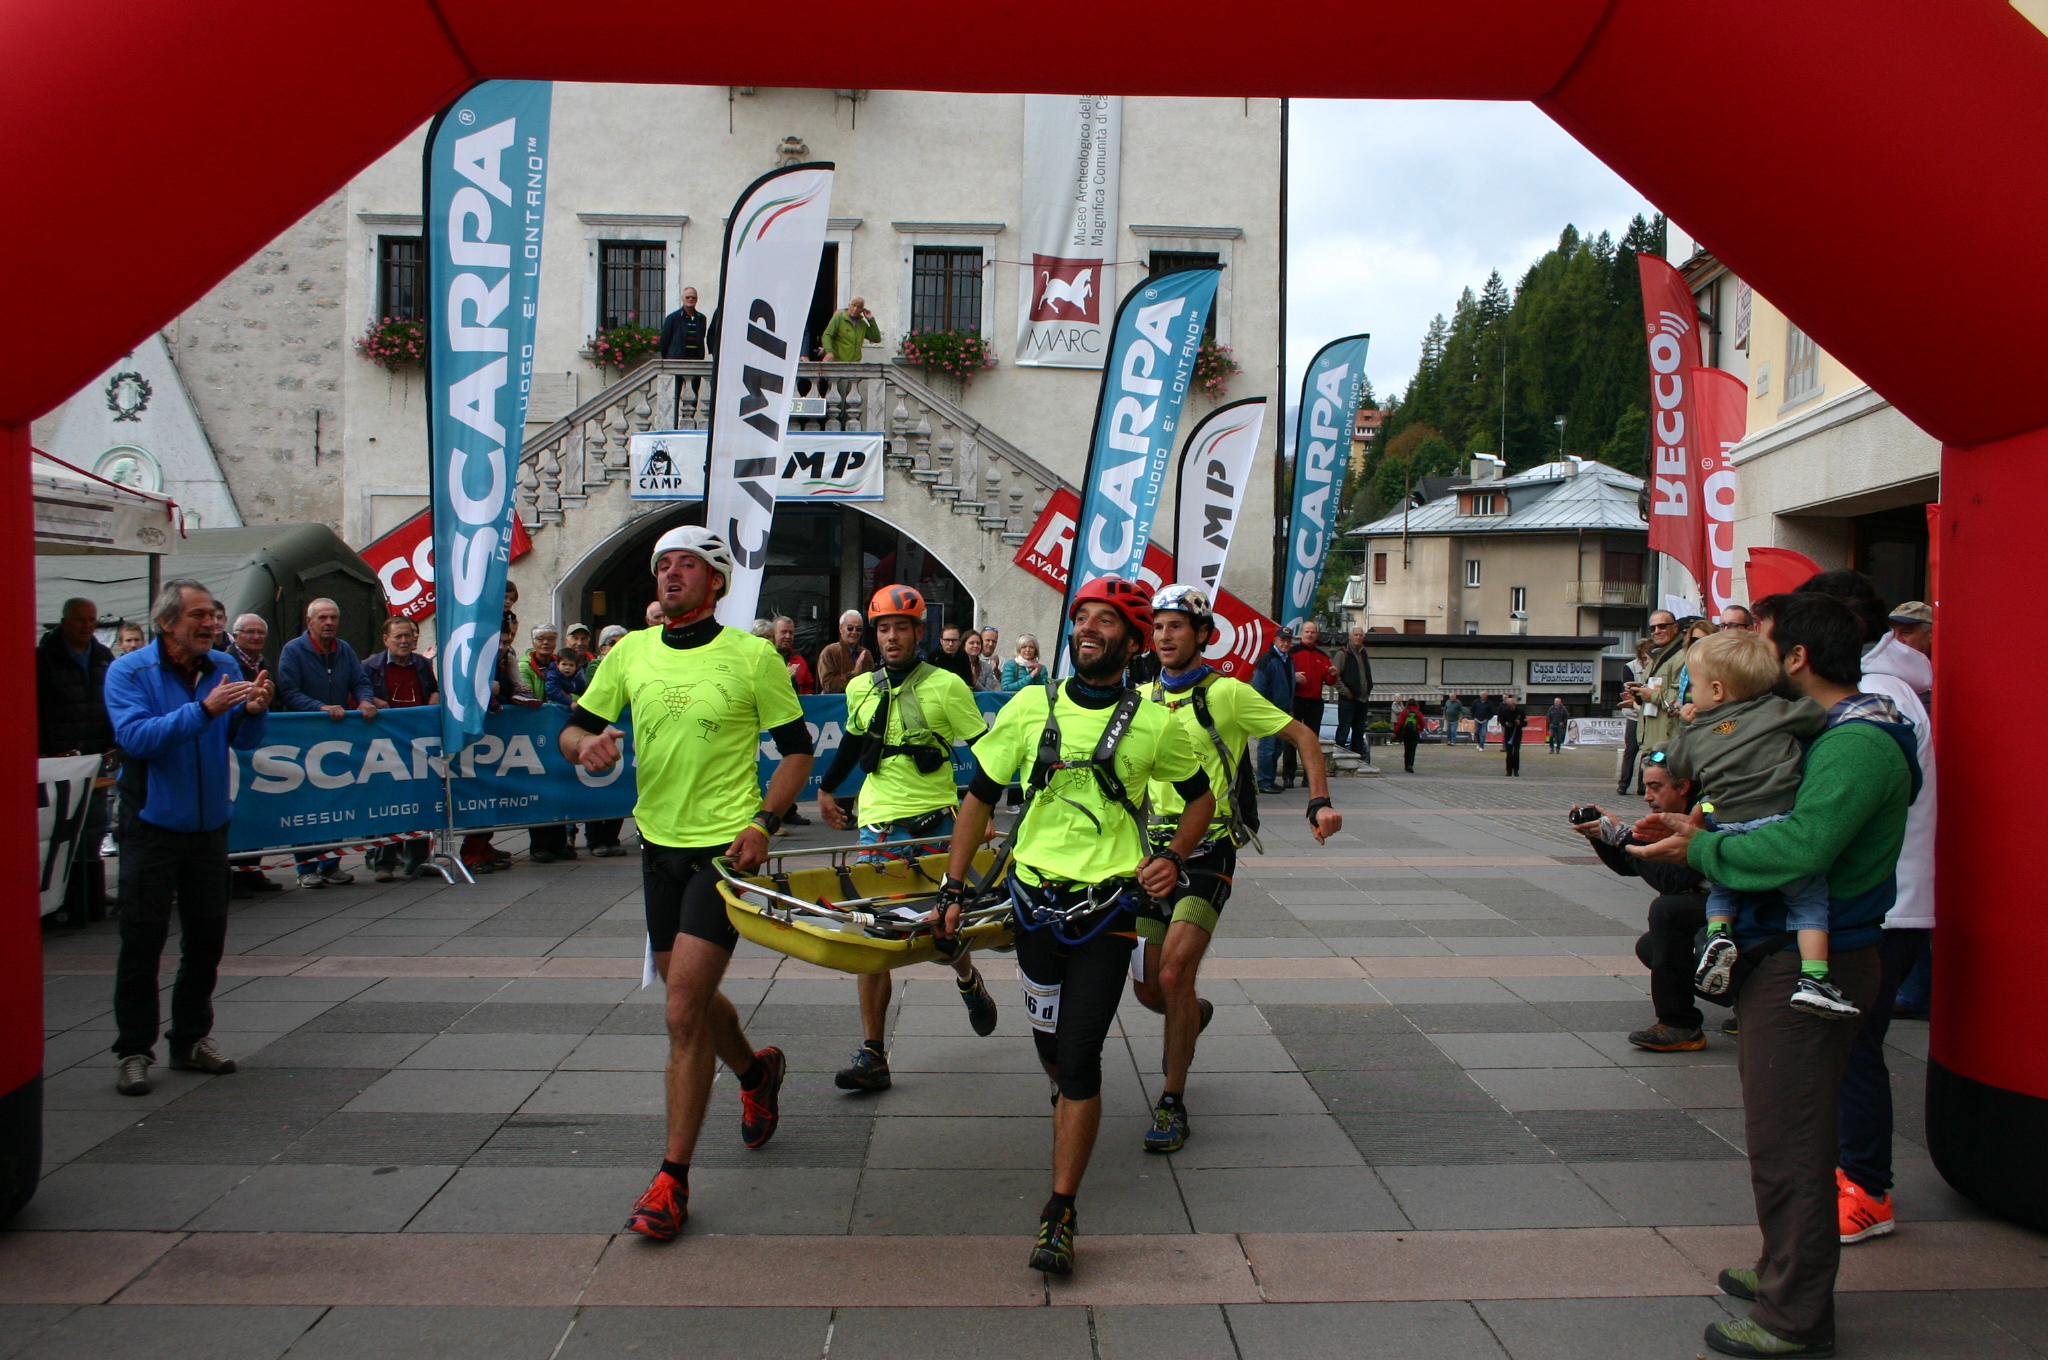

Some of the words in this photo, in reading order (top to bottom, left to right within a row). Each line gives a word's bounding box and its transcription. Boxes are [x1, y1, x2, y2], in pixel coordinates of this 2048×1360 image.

[1097, 113, 1107, 125] di
[1075, 122, 1092, 203] Archeologico
[1093, 128, 1107, 185] Comunità
[1074, 206, 1087, 246] Museo
[1091, 189, 1107, 246] Magnifica
[1026, 328, 1100, 353] MARC
[729, 298, 787, 570] CAMP
[781, 451, 866, 479] MP
[1144, 448, 1167, 506] LUOGO
[639, 477, 682, 491] CAMP
[1330, 479, 1343, 523] LUOGO
[1201, 459, 1235, 588] AMP
[1026, 553, 1068, 585] AVALA
[402, 591, 435, 617] RESC
[1533, 662, 1554, 674] Casa
[1555, 662, 1569, 674] del
[1570, 662, 1592, 674] Dolce
[1540, 674, 1585, 682] Pasticceria
[1590, 720, 1623, 728] OTTICA
[280, 809, 356, 829] NESSUN
[369, 803, 420, 819] LUOGO
[1042, 1005, 1054, 1020] d
